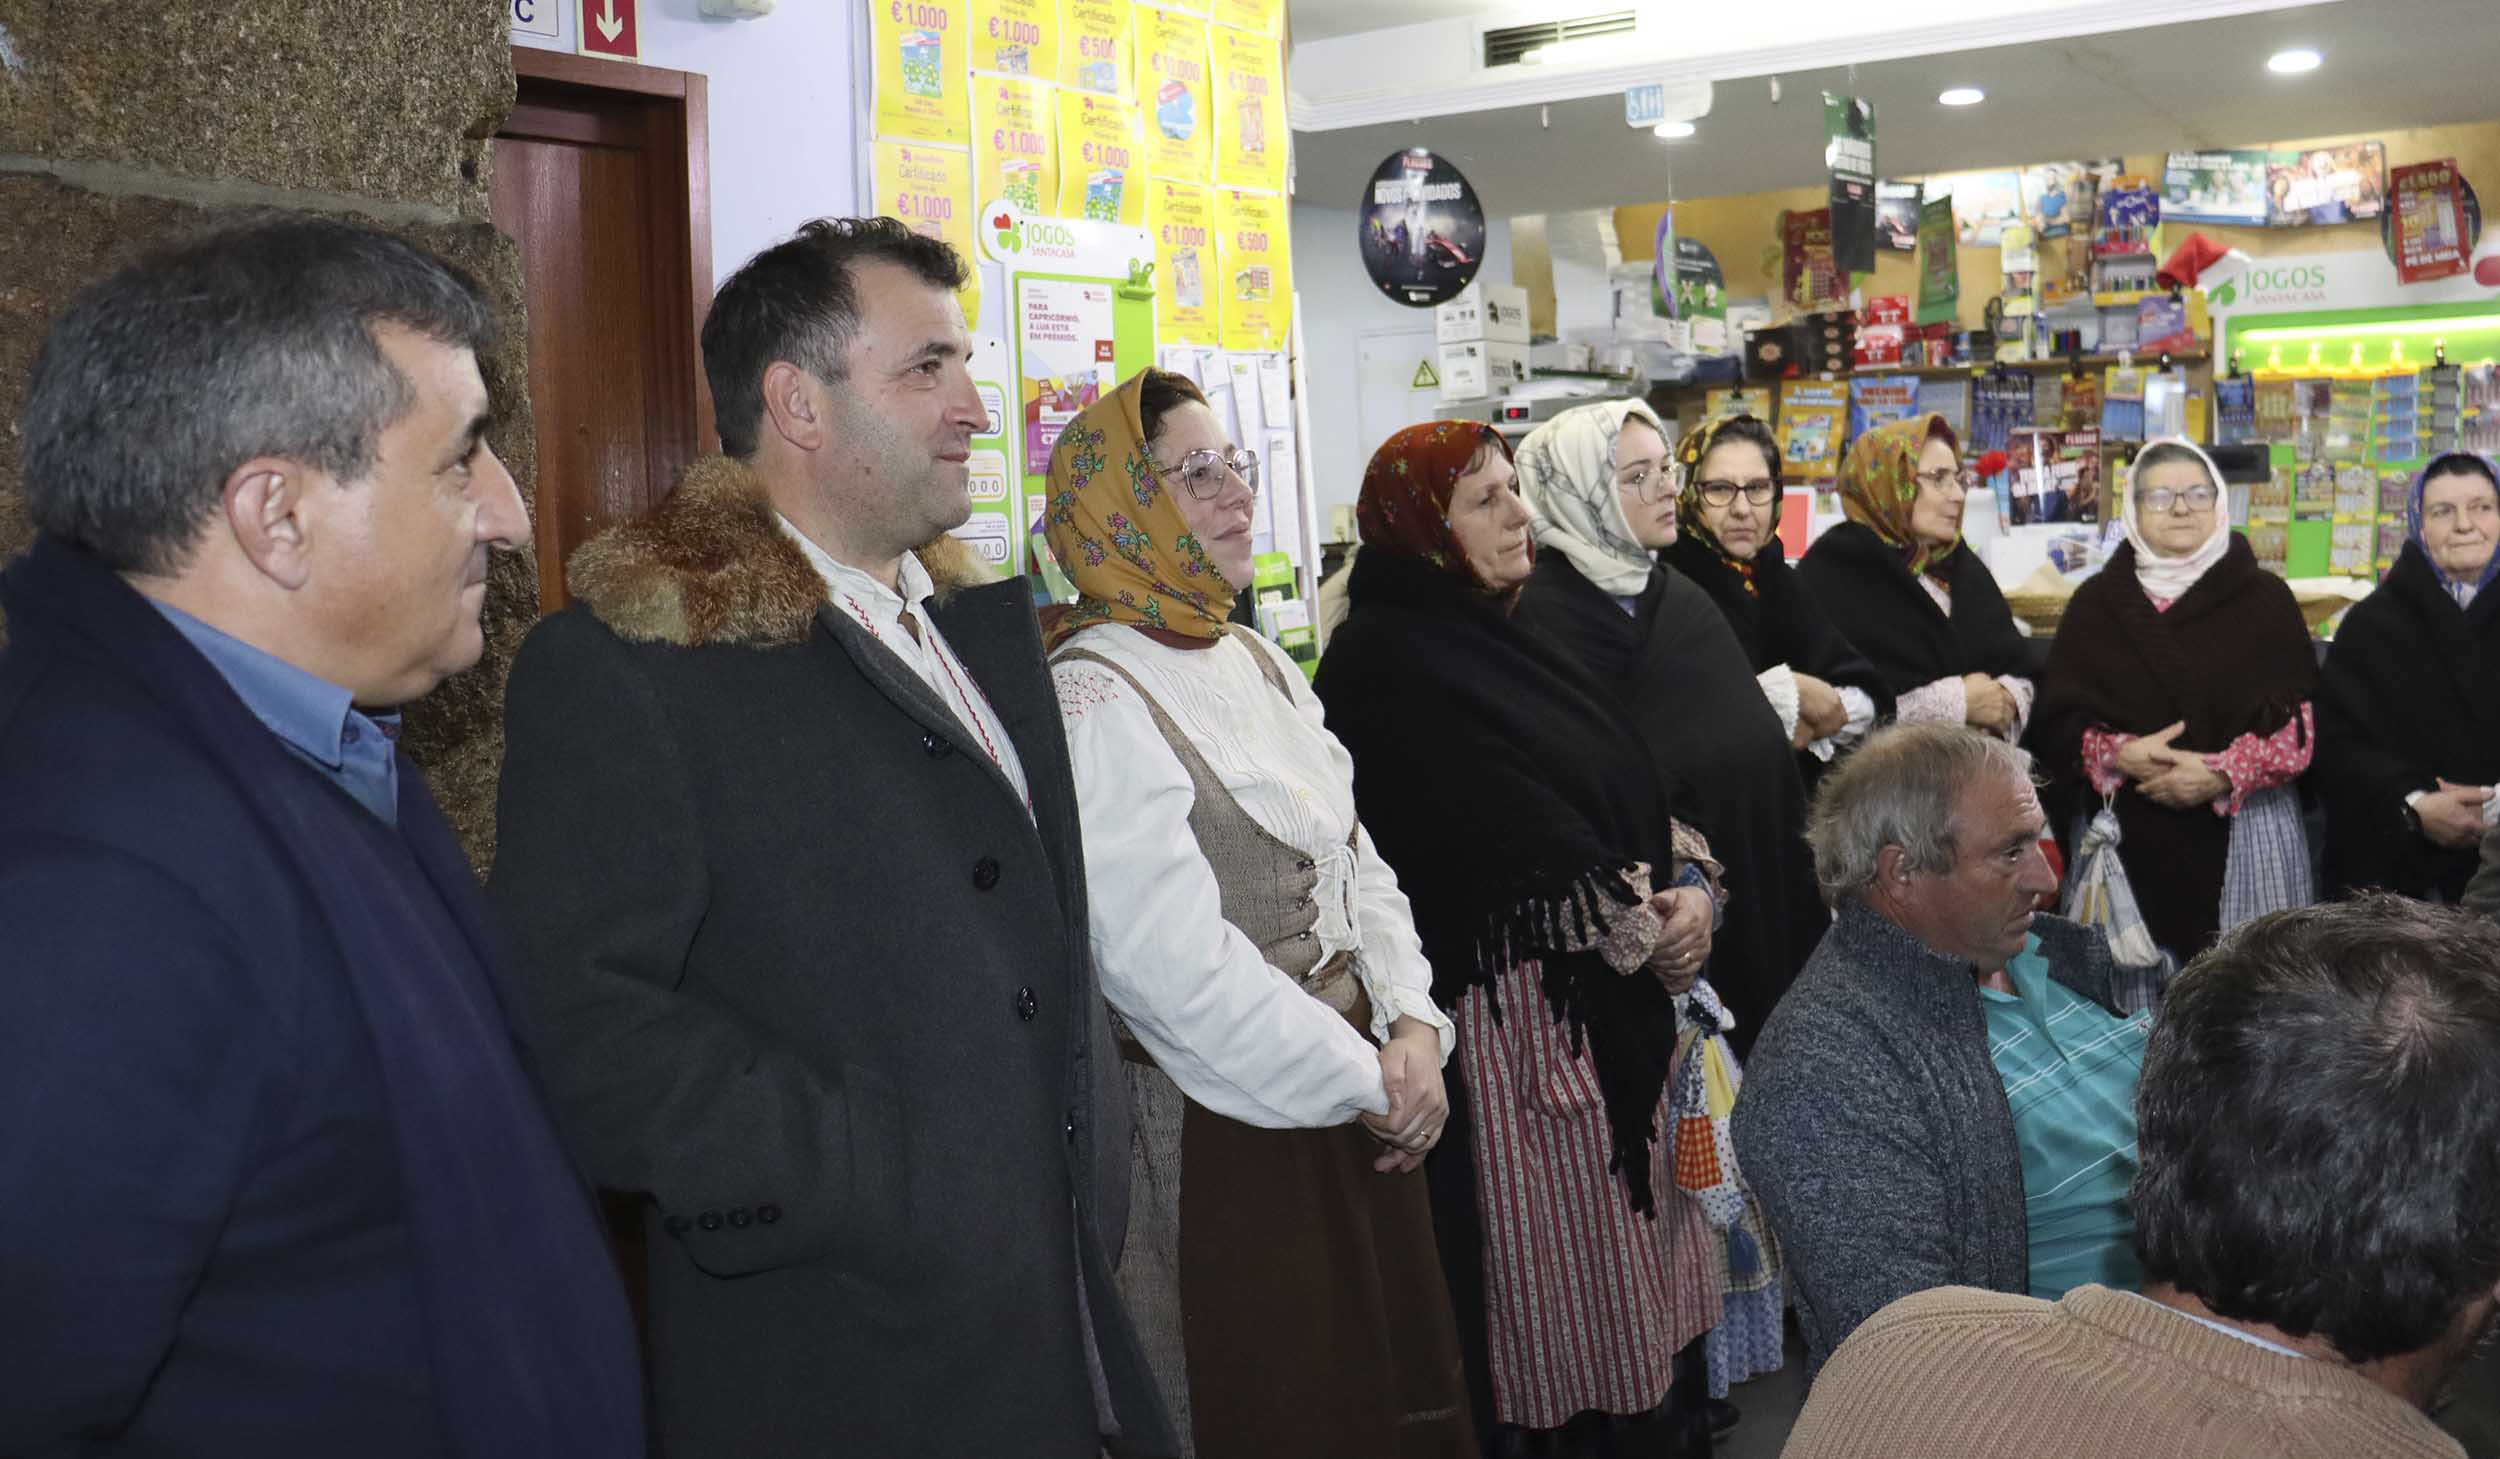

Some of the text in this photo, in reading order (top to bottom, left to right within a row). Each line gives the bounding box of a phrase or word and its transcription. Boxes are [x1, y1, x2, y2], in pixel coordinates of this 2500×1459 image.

[891, 0, 948, 31] € 1.000
[989, 16, 1040, 46] € 1.000
[993, 128, 1046, 155] € 1.000
[1082, 141, 1129, 168] € 1.000
[897, 192, 952, 219] € 1.000
[1026, 223, 1076, 248] JOGOS
[1162, 223, 1206, 247] € 1.000
[1247, 232, 1268, 252] 500
[2243, 265, 2326, 298] JOGOS
